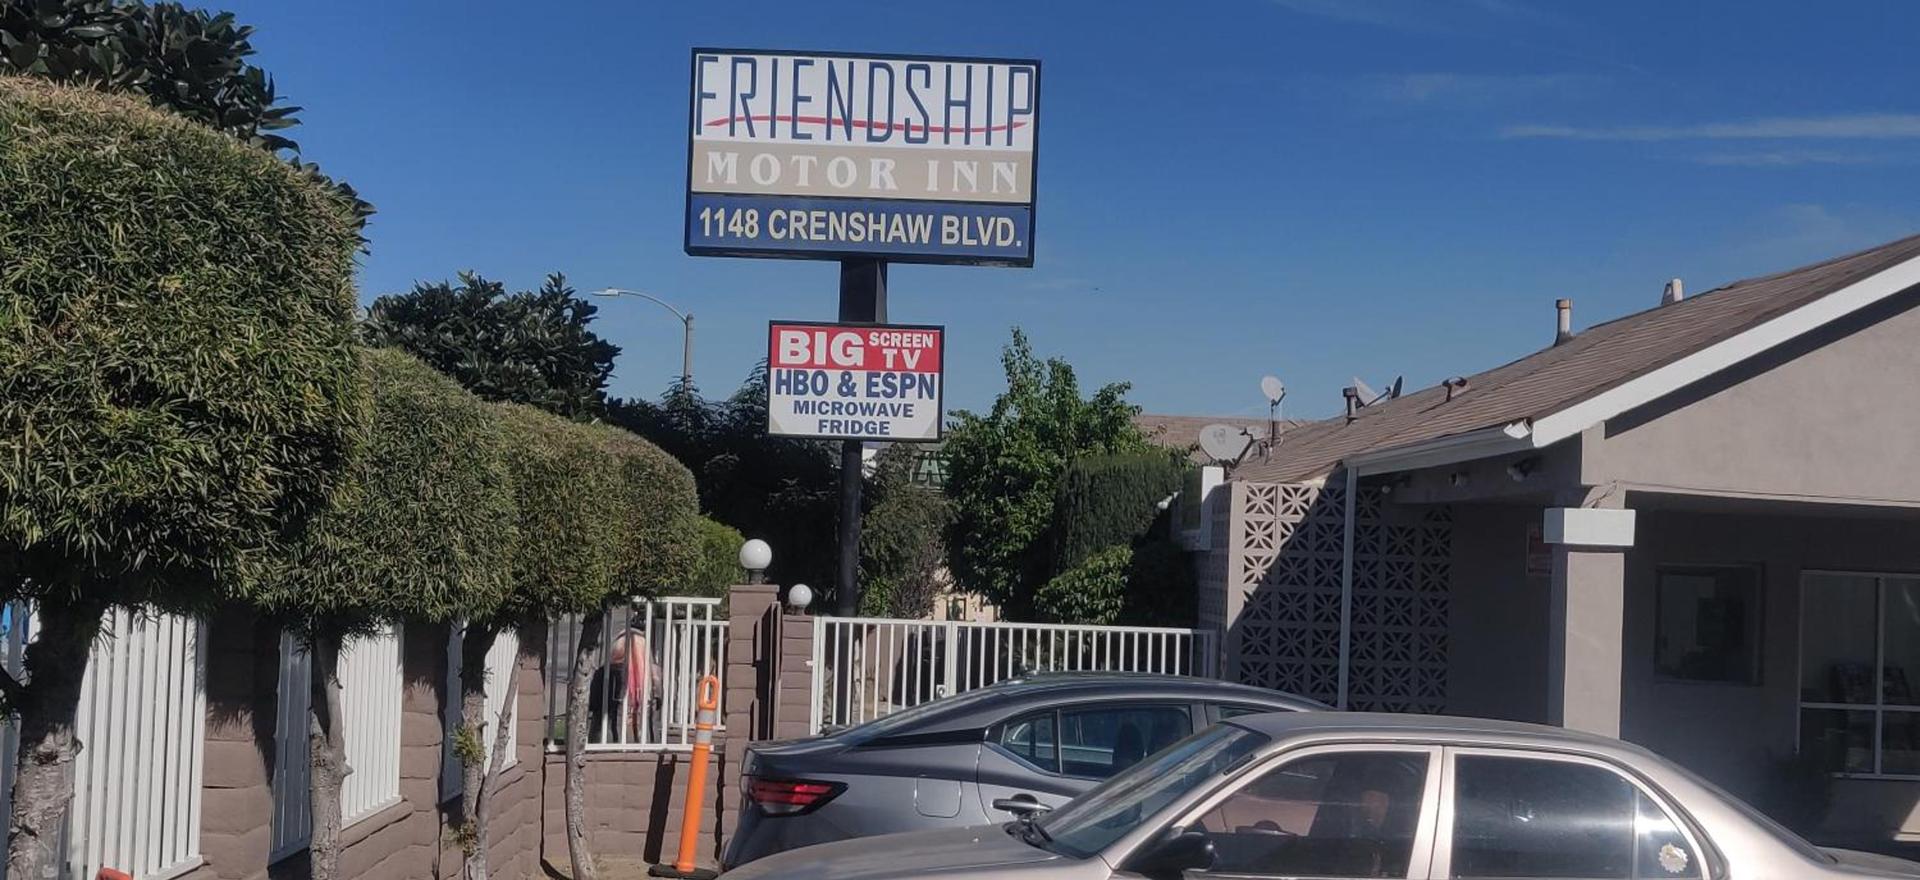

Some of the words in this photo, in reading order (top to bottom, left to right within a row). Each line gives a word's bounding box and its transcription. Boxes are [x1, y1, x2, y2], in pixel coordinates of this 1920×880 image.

[696, 56, 1034, 146] FRIENDSHIP
[706, 152, 898, 191] MOTOR
[927, 160, 1018, 194] INN
[700, 207, 759, 239] 1148
[768, 210, 934, 244] CRENSHAW
[941, 215, 1022, 247] BLVD.
[779, 330, 864, 367] BIG
[869, 331, 934, 348] SCREEN
[883, 348, 921, 369] TV
[775, 369, 829, 396] HBO
[837, 371, 857, 398] &
[866, 372, 934, 400] ESPN
[793, 400, 914, 418] MICROWAVE
[818, 419, 890, 436] FRIDGE
